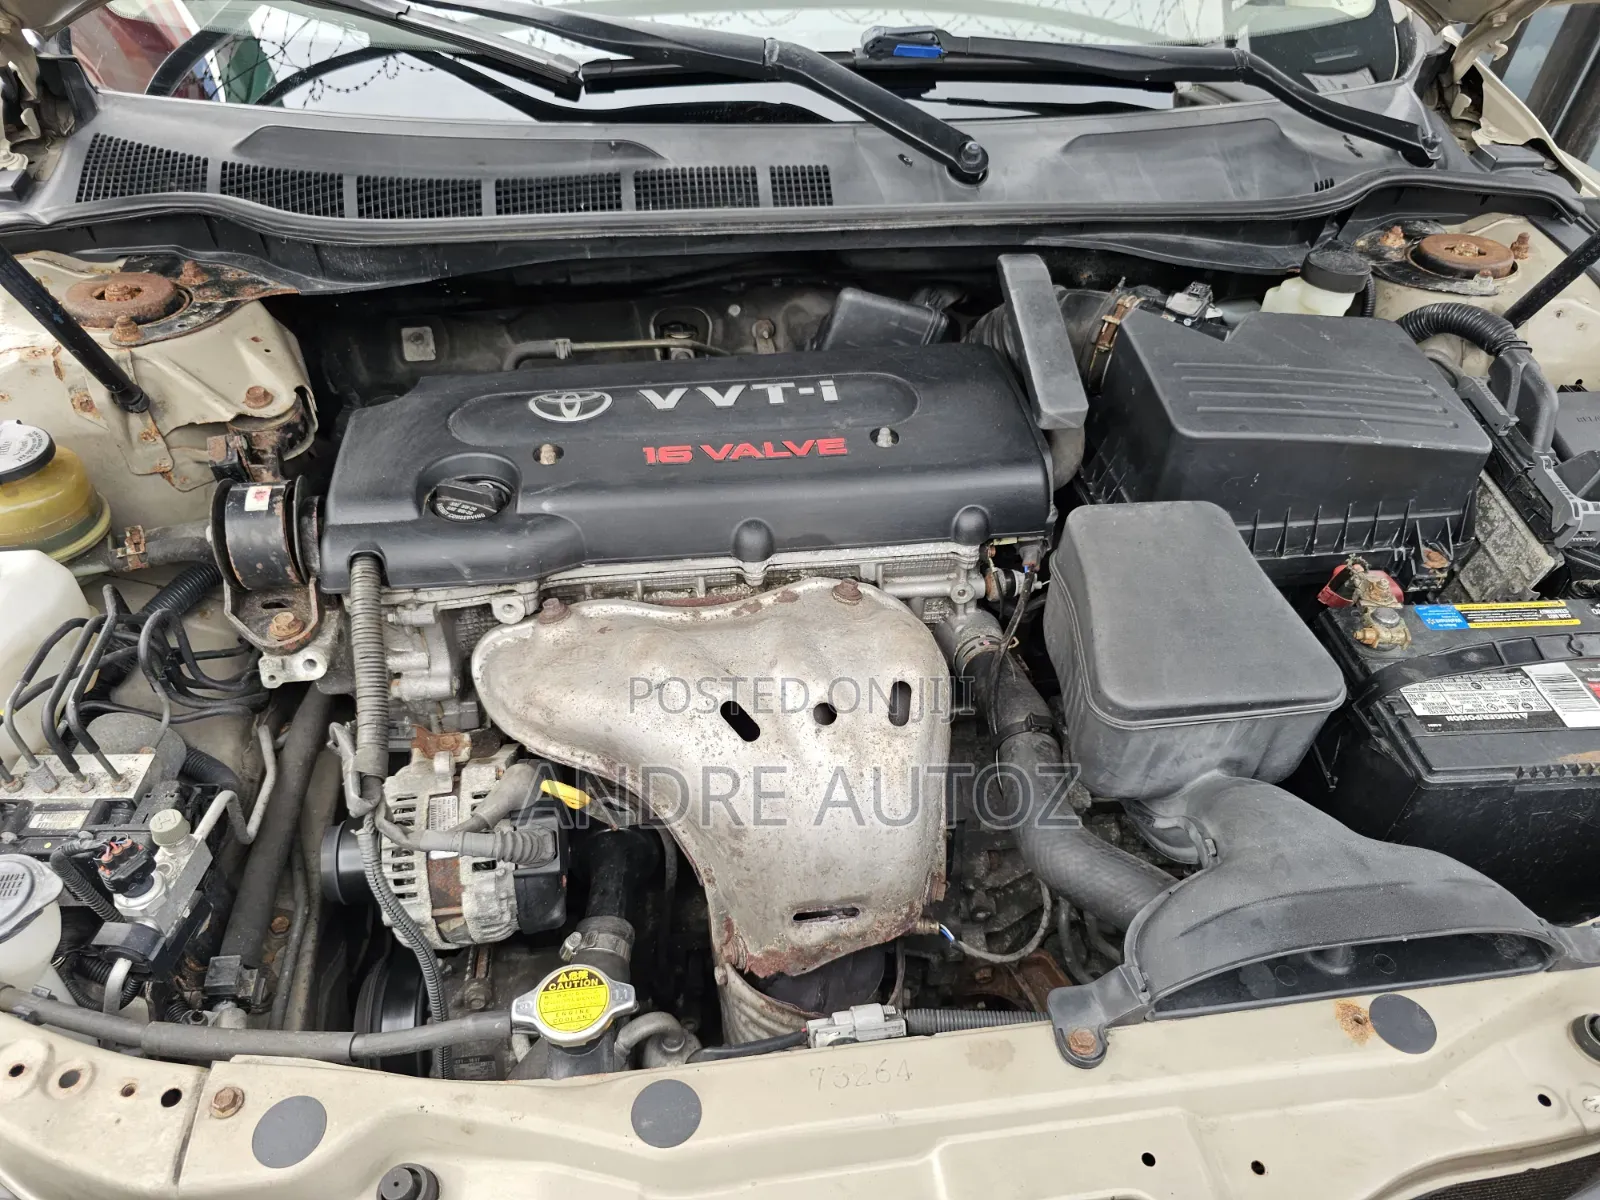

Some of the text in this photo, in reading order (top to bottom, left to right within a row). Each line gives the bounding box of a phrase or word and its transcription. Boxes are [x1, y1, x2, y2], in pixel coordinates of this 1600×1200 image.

[638, 379, 840, 411] VVT-i
[643, 437, 848, 466] 16 VALVE
[548, 978, 599, 991] CAUTION
